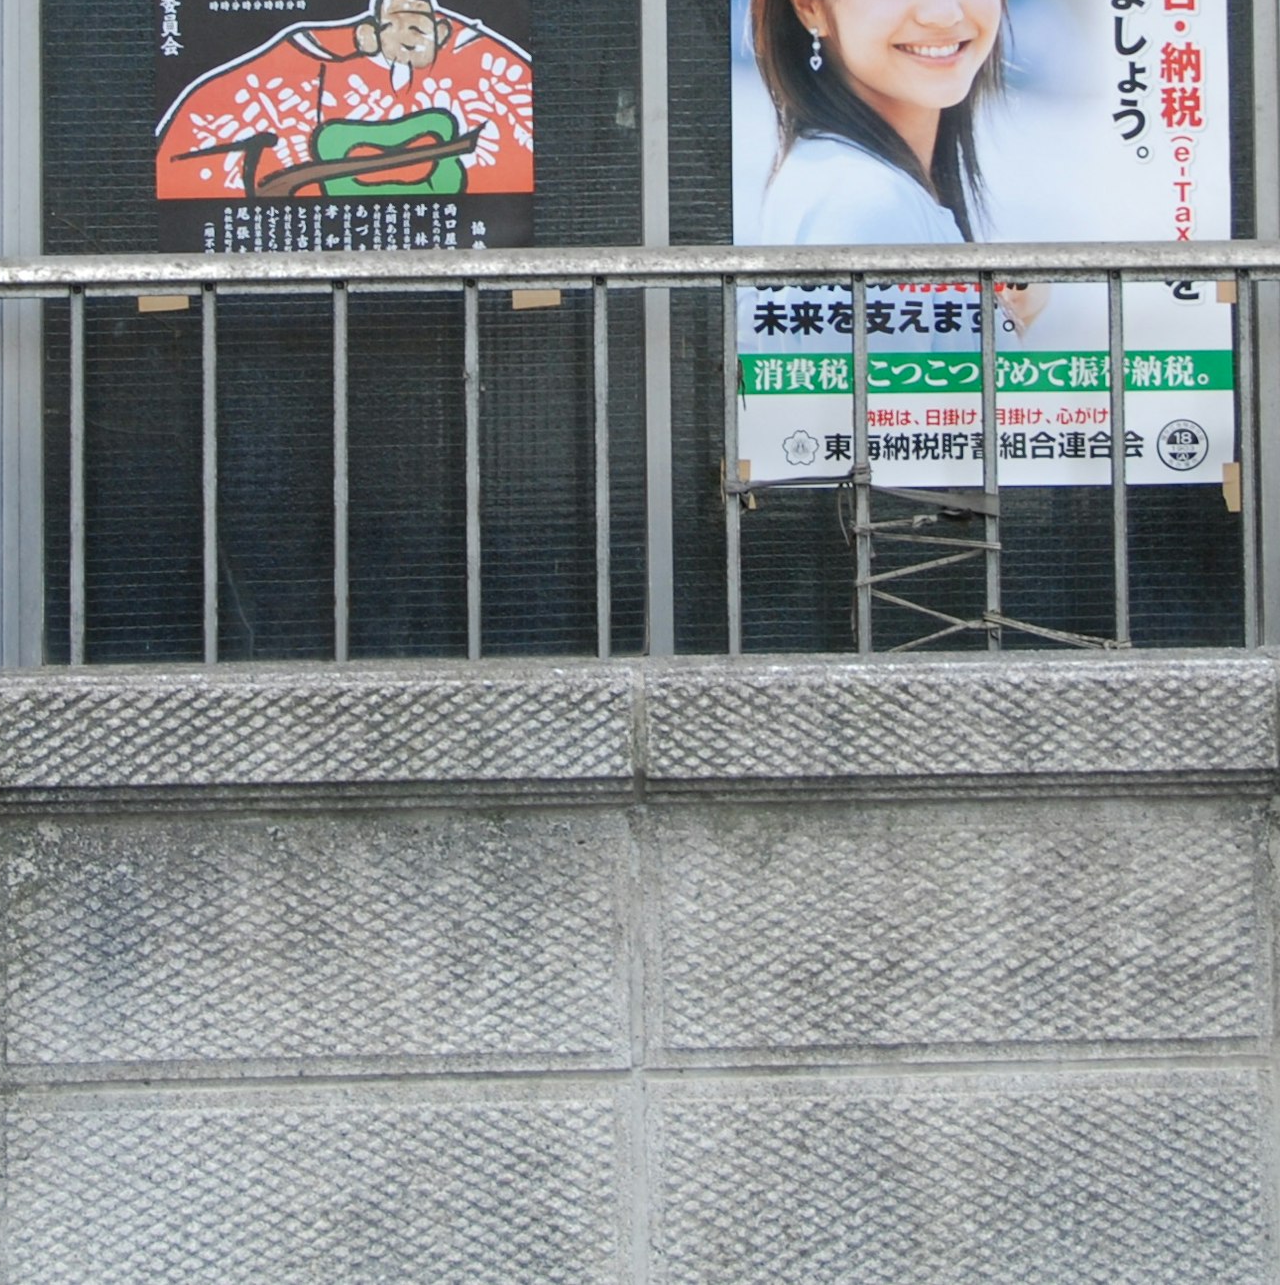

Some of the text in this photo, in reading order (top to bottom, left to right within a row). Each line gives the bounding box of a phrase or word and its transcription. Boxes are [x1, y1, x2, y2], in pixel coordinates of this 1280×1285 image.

[266, 206, 279, 252] 小ざくら
[297, 206, 308, 252] とう吉
[444, 203, 458, 250] 両口屋
[753, 301, 1015, 336] 未来を支えます。
[1174, 432, 1192, 444] 18
